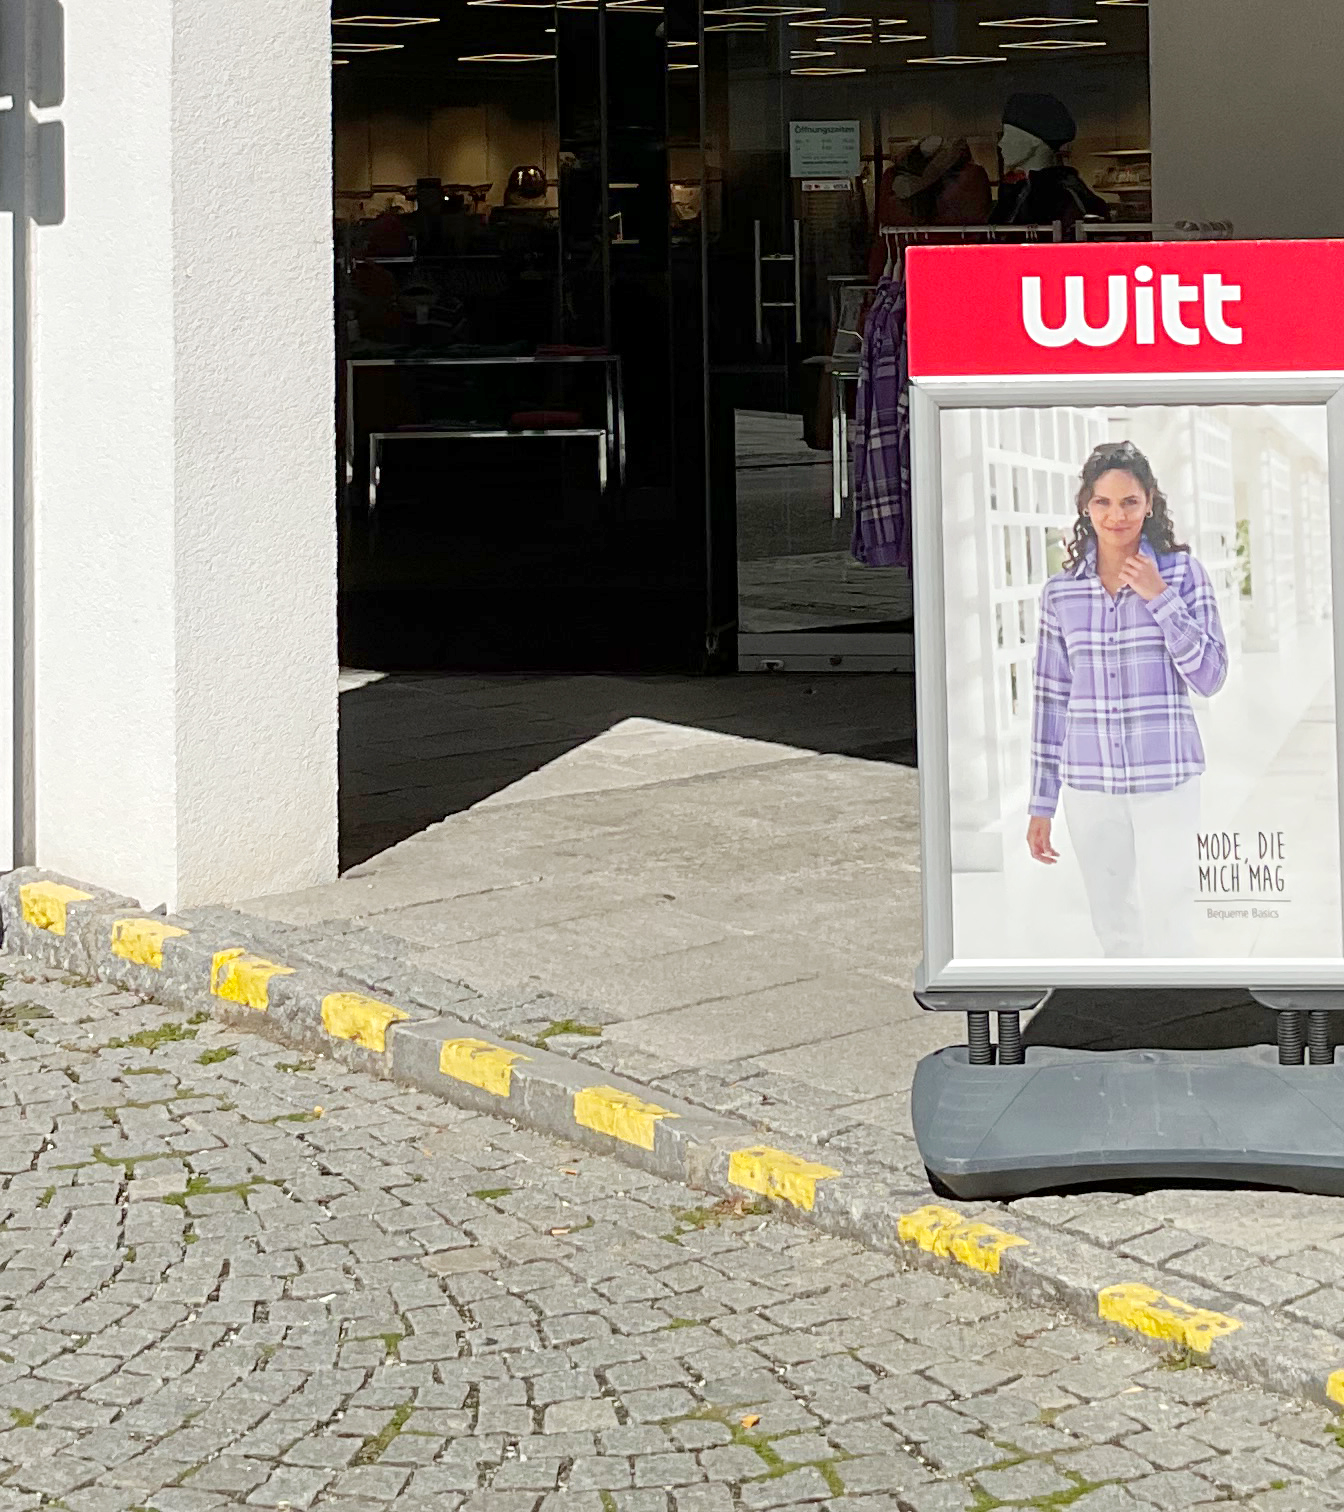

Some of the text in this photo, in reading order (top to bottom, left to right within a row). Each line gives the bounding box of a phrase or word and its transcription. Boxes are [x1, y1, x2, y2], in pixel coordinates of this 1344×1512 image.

[794, 125, 855, 135] Öffnungszeiten
[1022, 265, 1243, 347] Witt
[1197, 831, 1285, 864] MODE, DIE
[1198, 863, 1285, 892] MICH MAG
[1207, 908, 1279, 920] Bequeme Basics
